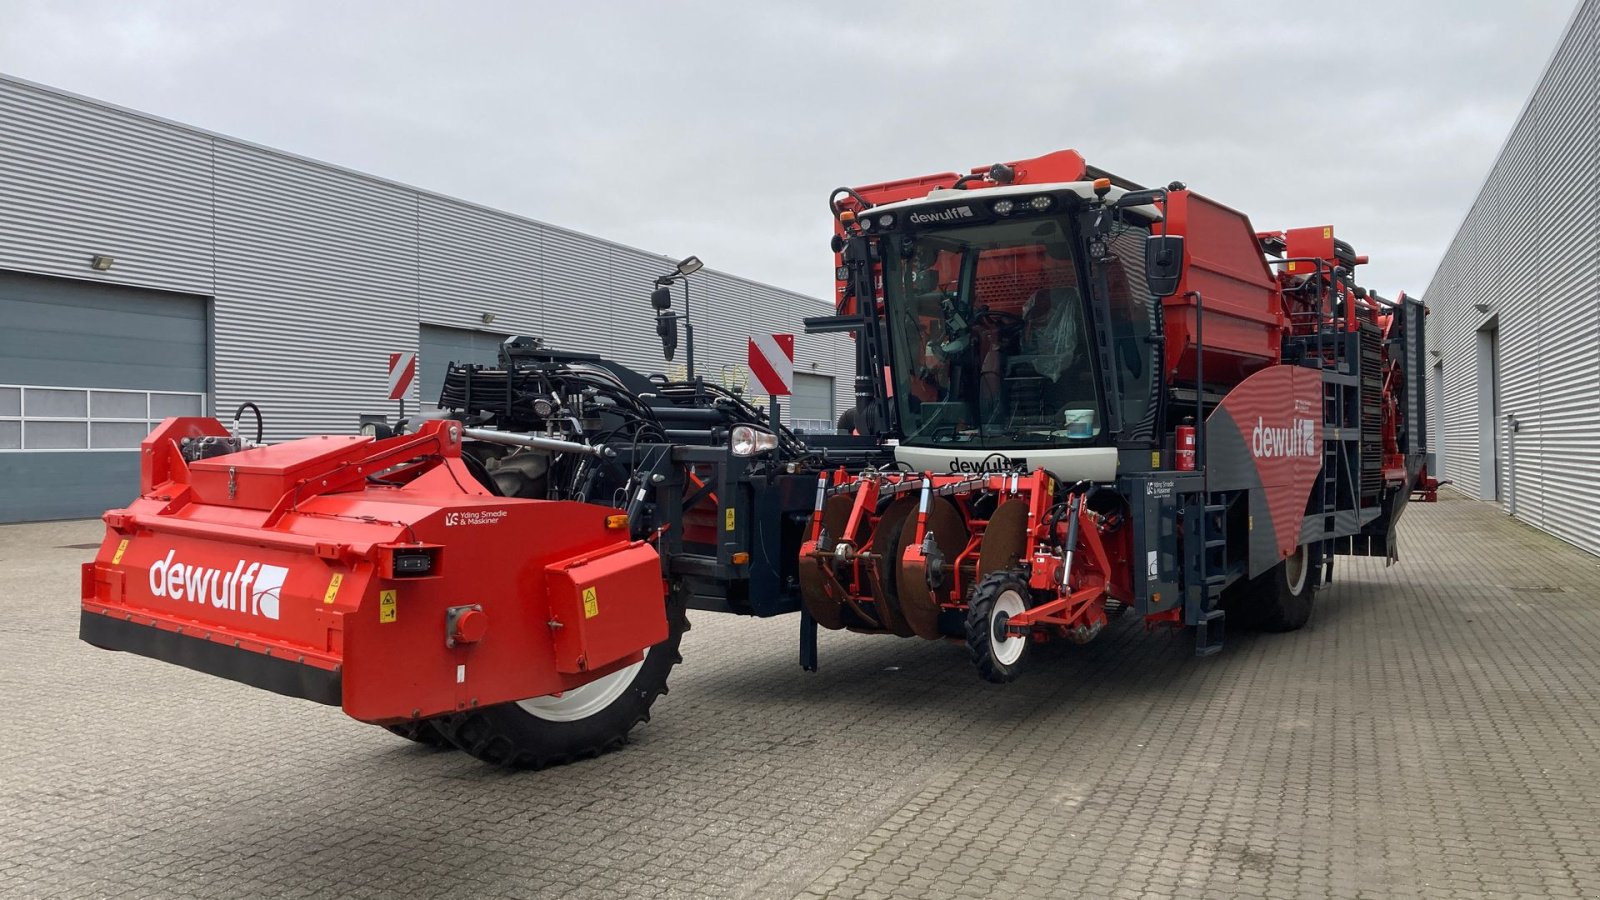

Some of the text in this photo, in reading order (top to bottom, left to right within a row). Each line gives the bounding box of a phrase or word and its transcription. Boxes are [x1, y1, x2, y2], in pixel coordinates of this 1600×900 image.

[909, 207, 959, 223] dewulf
[1252, 416, 1303, 458] dewulf
[460, 509, 508, 519] Yding Smedie
[460, 517, 499, 526] & Maskiner
[149, 549, 260, 613] dewulf
